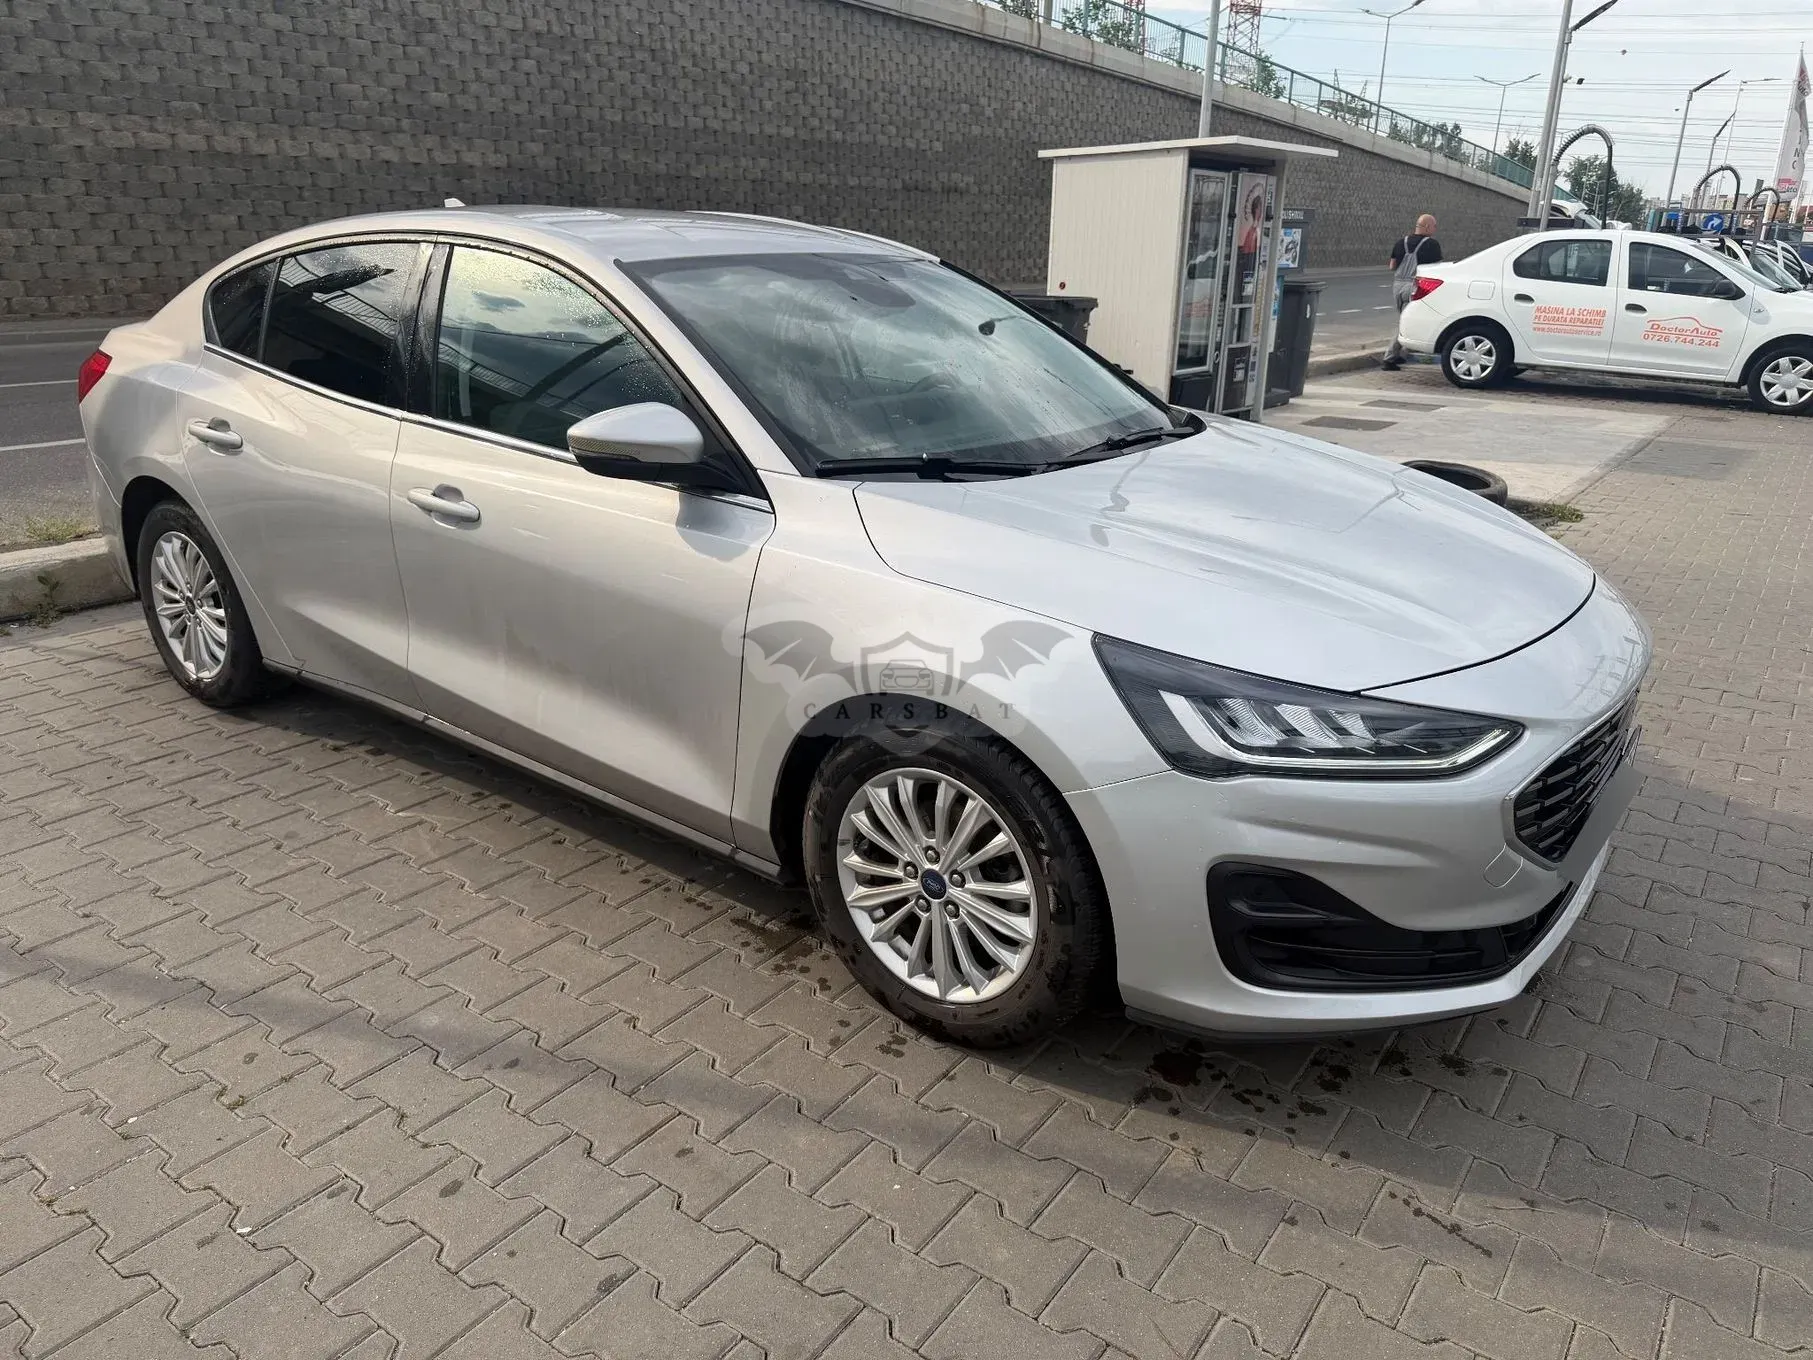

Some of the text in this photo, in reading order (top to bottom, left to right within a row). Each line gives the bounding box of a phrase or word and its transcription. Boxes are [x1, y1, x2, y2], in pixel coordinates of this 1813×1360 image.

[1535, 305, 1607, 317] MASINA LA SCHIMB
[1543, 315, 1568, 323] DURATA
[1568, 317, 1604, 325] REPARATIEI
[1650, 323, 1717, 336] DoctorAuto
[1643, 333, 1719, 347] 0726.744.244
